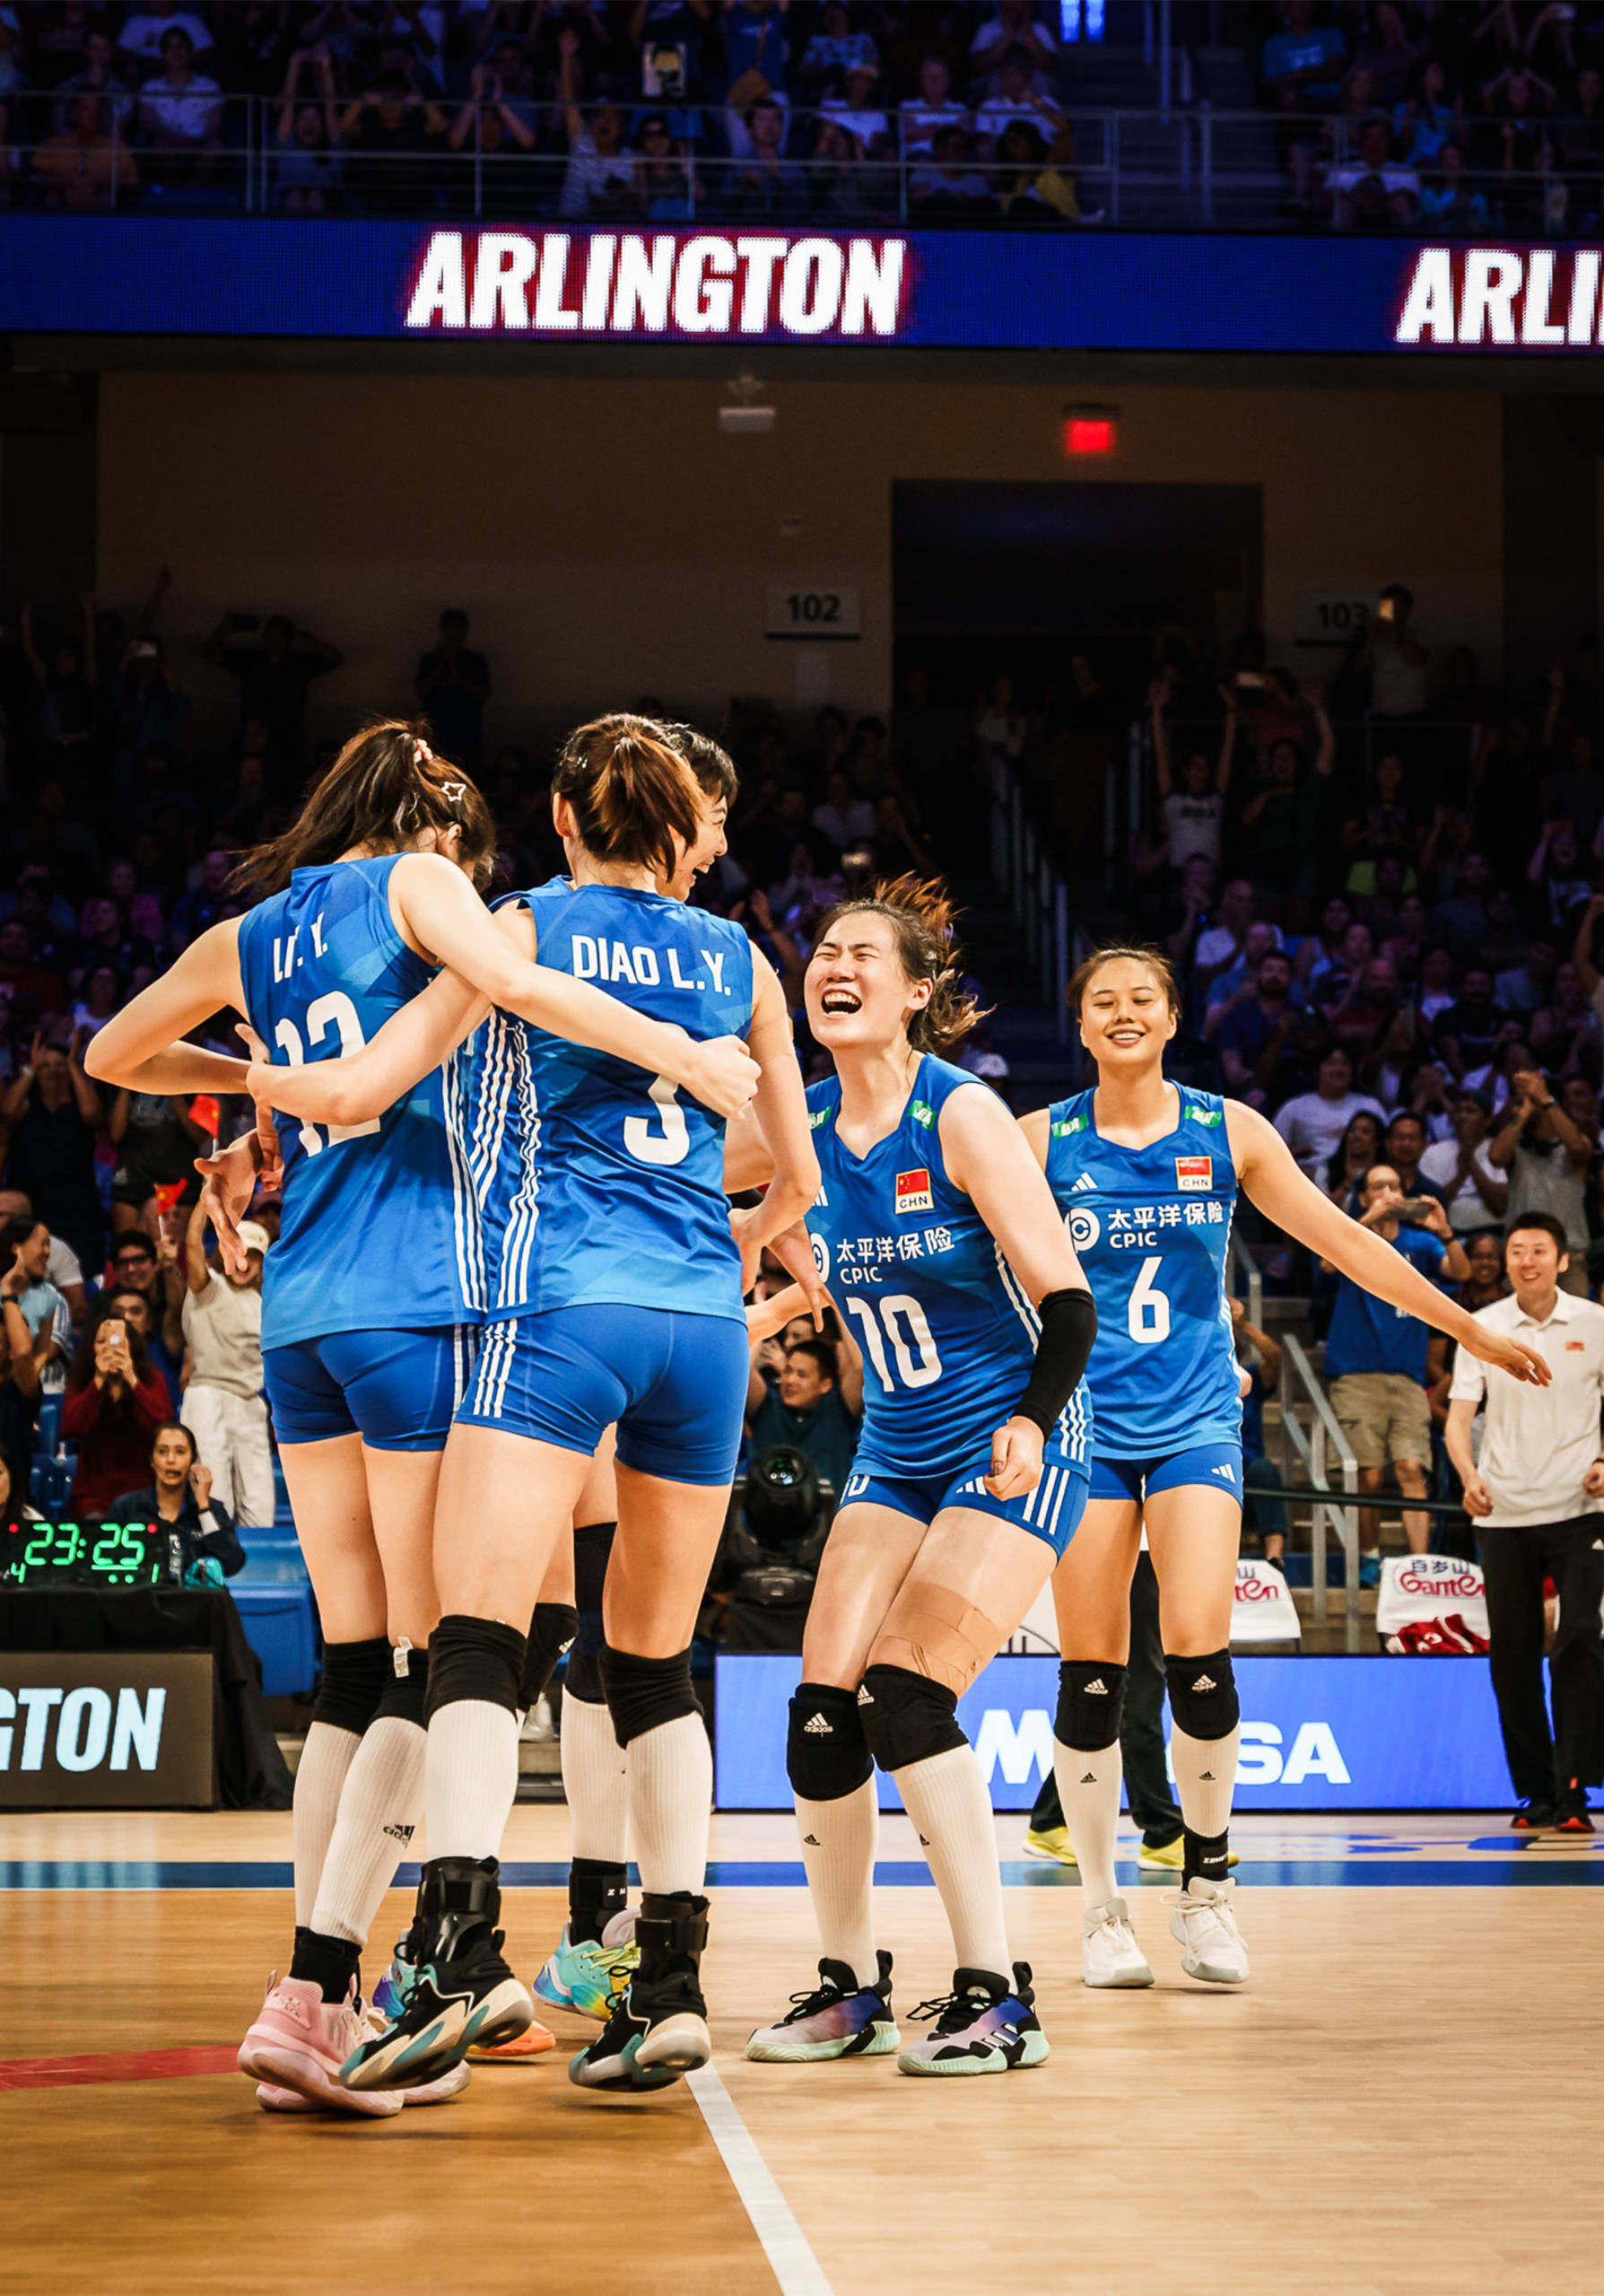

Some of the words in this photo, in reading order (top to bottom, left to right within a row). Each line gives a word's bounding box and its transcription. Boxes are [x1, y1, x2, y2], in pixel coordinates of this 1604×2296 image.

[404, 231, 907, 336] ARLINGTON
[1394, 248, 1604, 345] ARLI
[788, 593, 841, 623] 102
[571, 934, 660, 986] DIAO
[667, 947, 731, 996] L.Y.
[1182, 1178, 1209, 1187] CHN
[899, 1195, 928, 1209] CHN
[1107, 1201, 1224, 1231] 太平洋保险
[836, 1227, 955, 1264] 太平洋保险
[1109, 1231, 1158, 1249] CPIC
[840, 1266, 884, 1284] CPIC
[1128, 1256, 1172, 1344] 6
[845, 1294, 943, 1392] 10
[11, 1562, 26, 1584] 4
[1411, 1559, 1470, 1575] 百岁山
